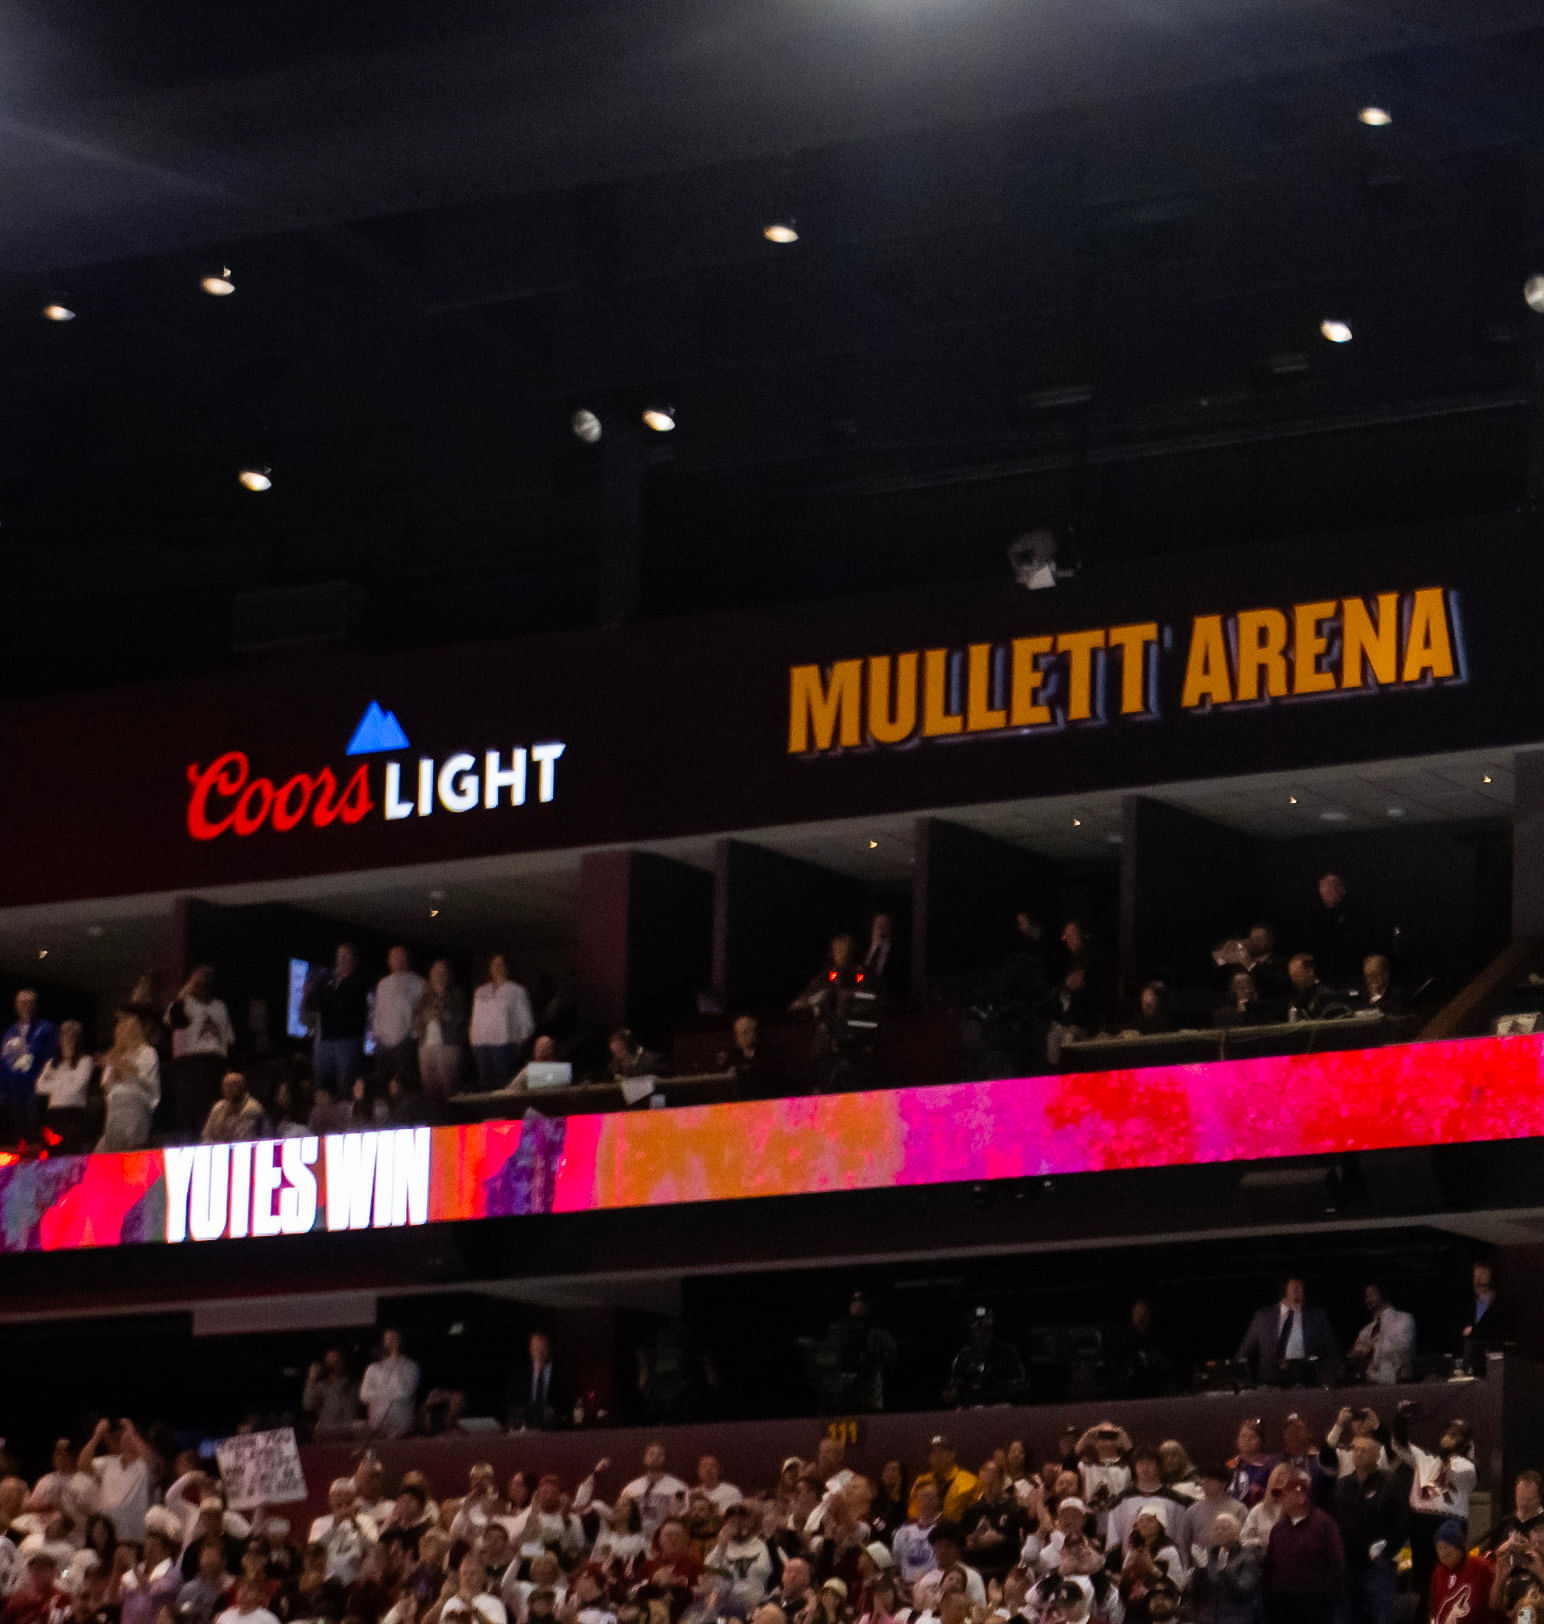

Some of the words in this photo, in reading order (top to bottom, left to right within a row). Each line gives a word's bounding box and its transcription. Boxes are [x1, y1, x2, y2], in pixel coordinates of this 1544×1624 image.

[788, 622, 1158, 754] MULLETT
[1182, 588, 1454, 707] ARENA
[187, 750, 374, 841] Coors
[384, 742, 566, 820] LIGHT
[325, 1127, 431, 1231] WIN
